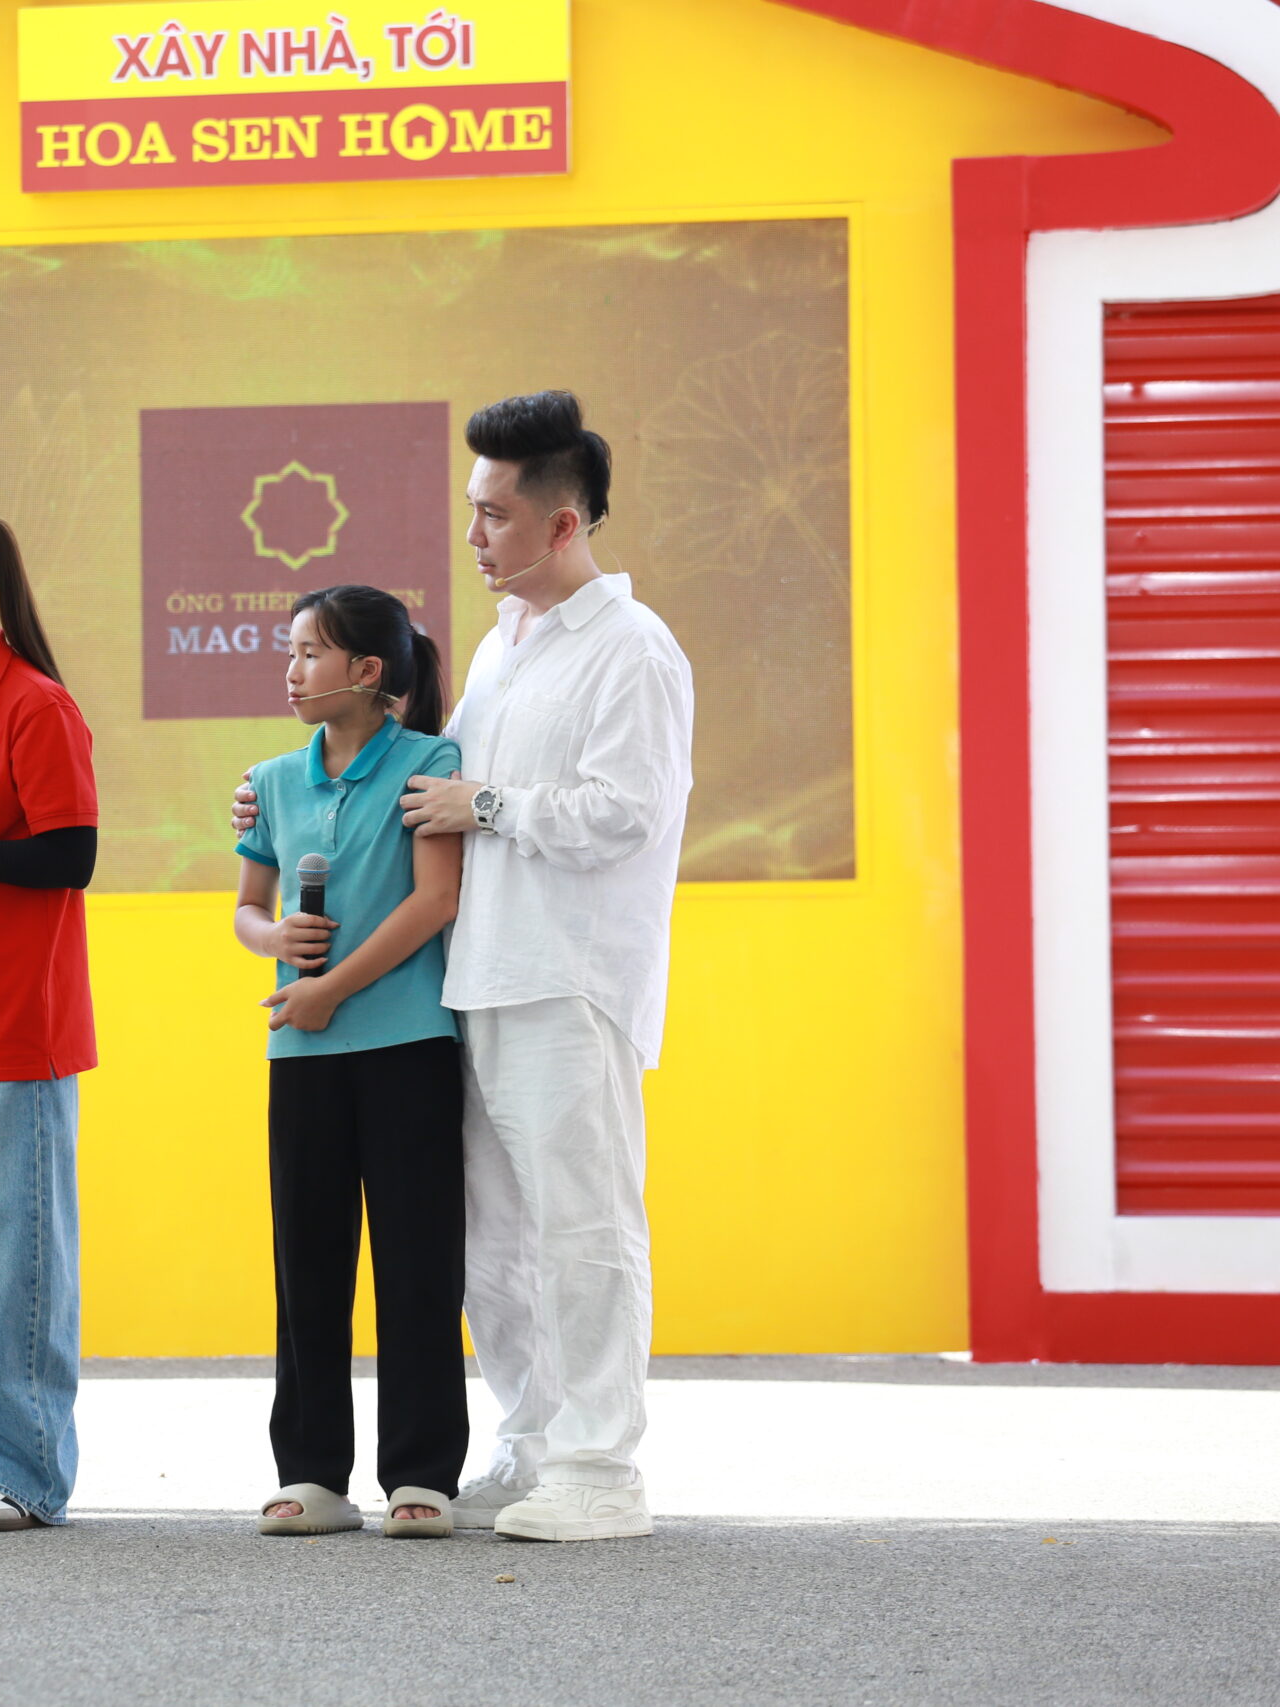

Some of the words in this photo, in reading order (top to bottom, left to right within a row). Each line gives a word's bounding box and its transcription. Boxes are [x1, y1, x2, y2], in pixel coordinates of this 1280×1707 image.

[115, 21, 225, 79] XÂY
[242, 15, 370, 78] NHÀ,
[387, 11, 470, 69] TỚI
[35, 121, 177, 168] HOA
[192, 114, 322, 163] SEN
[338, 103, 552, 161] HOME
[167, 624, 261, 655] MAG
